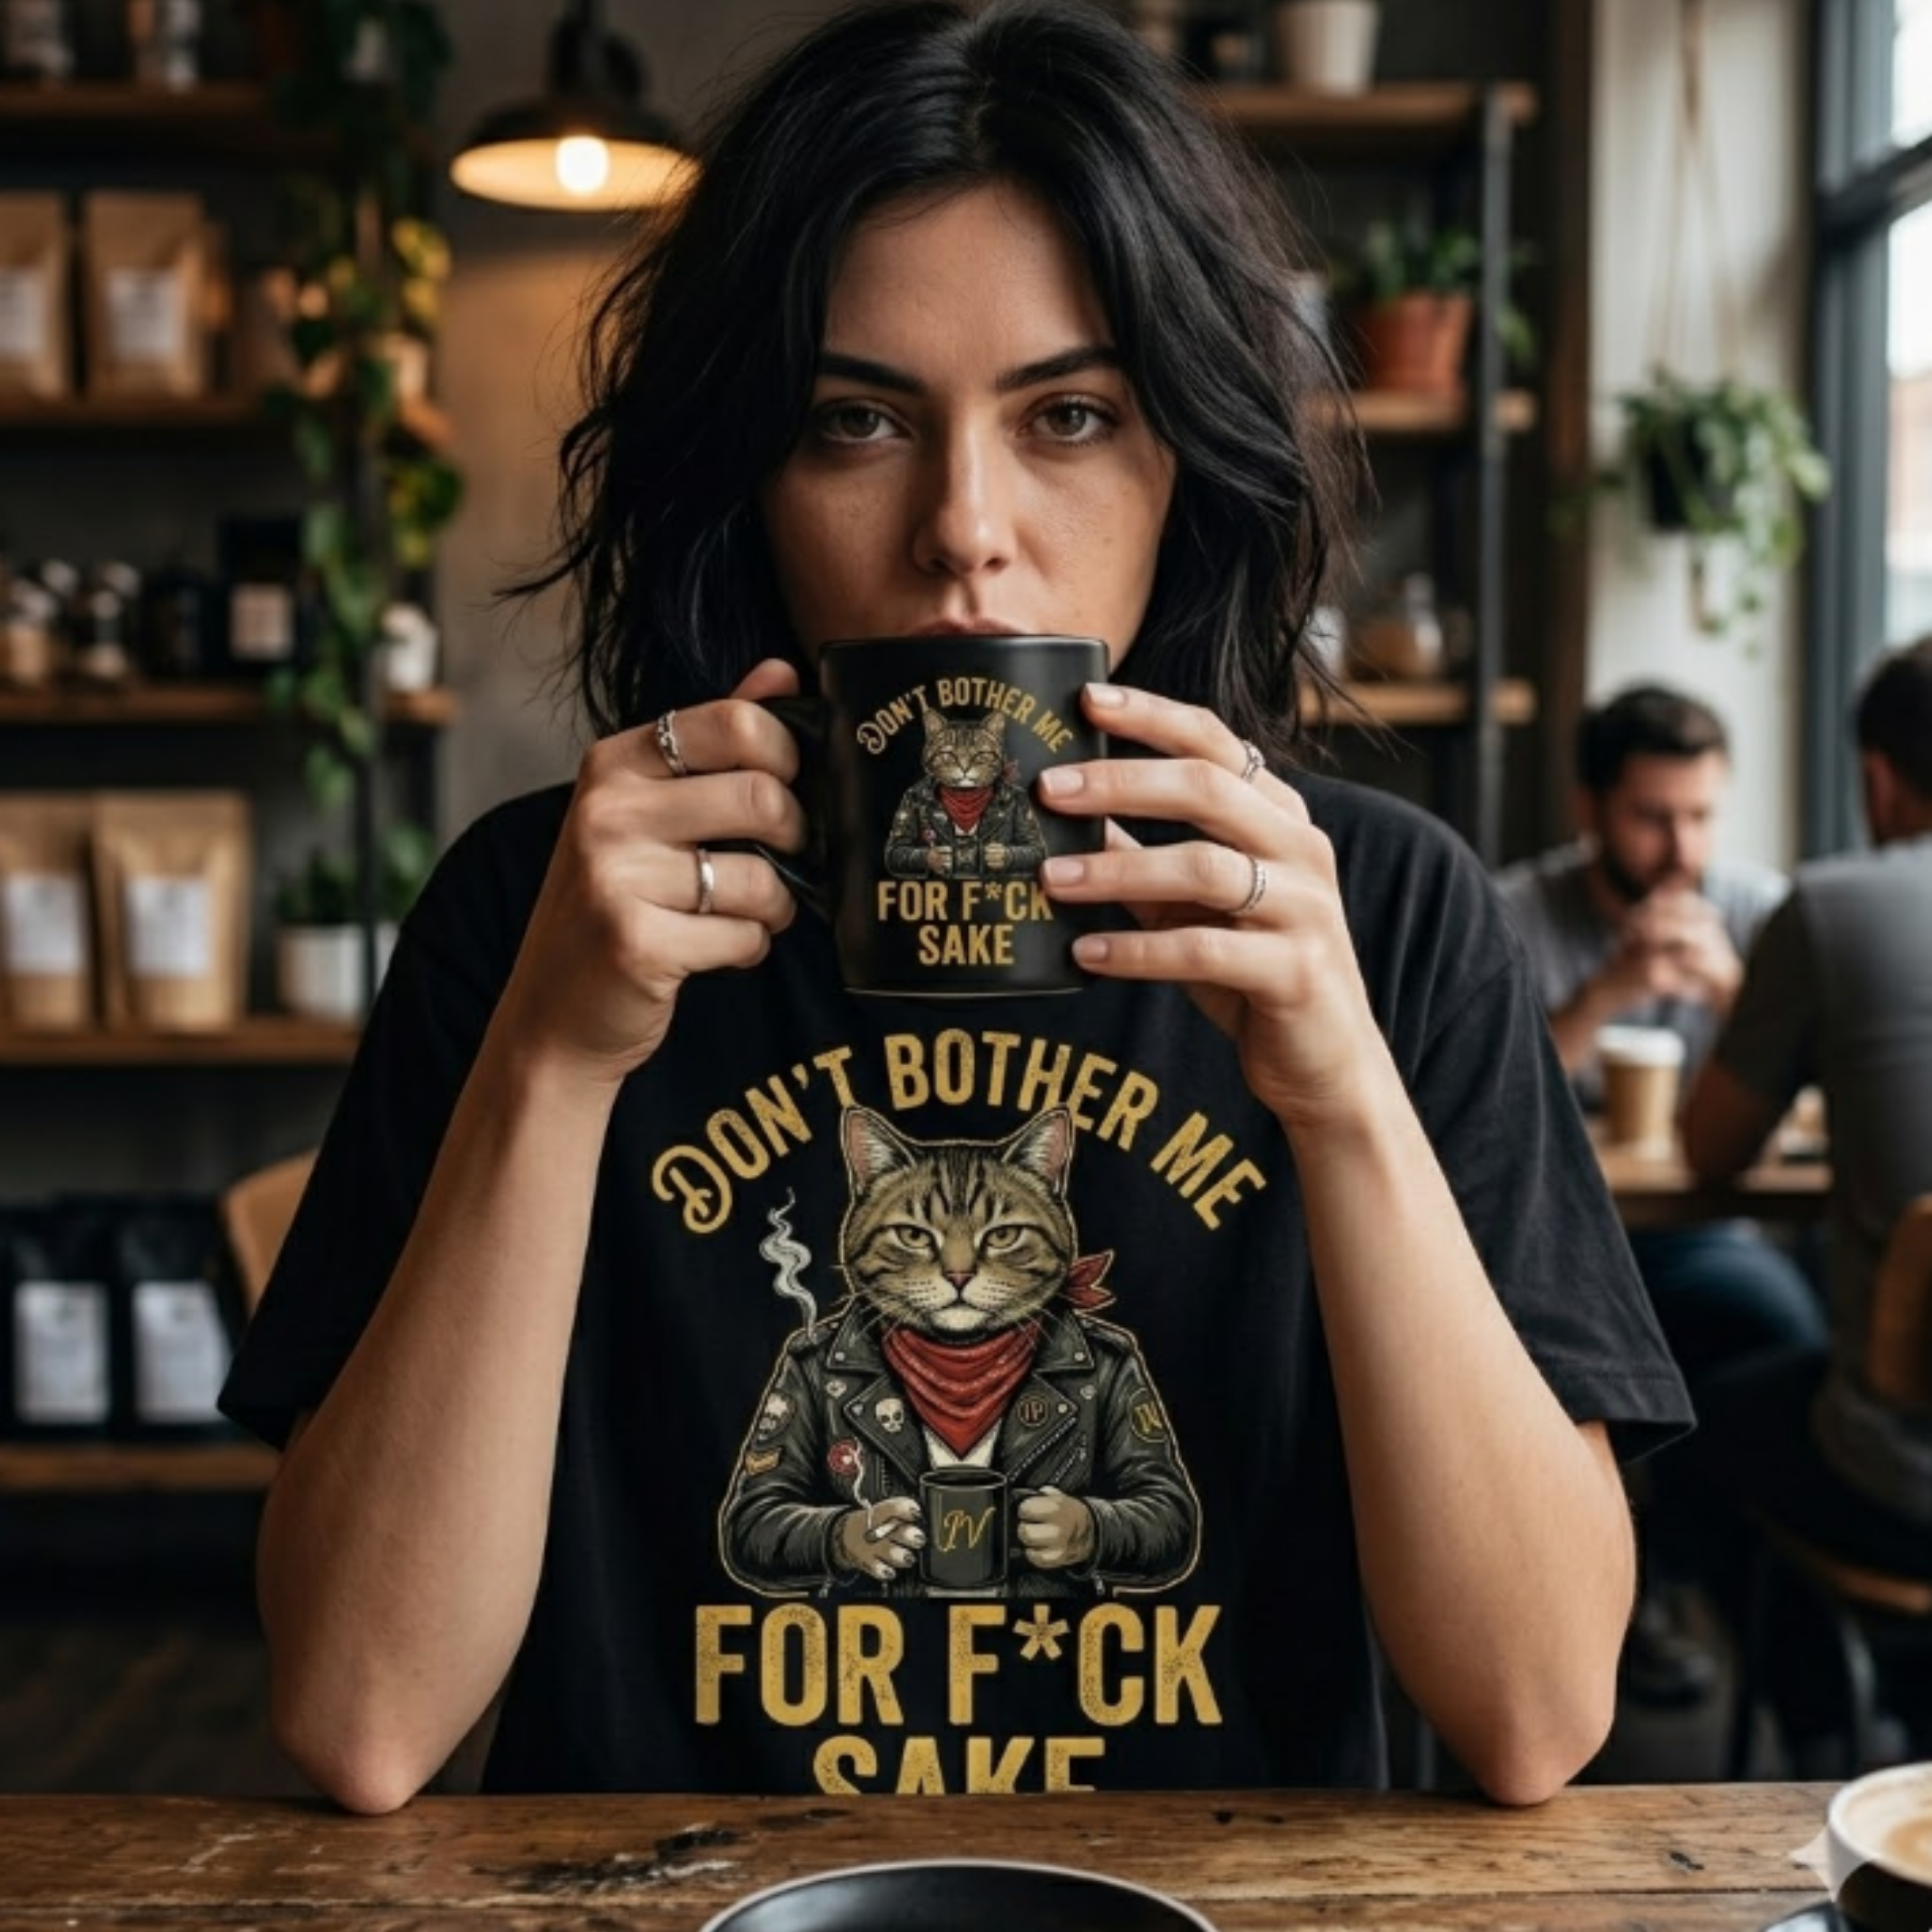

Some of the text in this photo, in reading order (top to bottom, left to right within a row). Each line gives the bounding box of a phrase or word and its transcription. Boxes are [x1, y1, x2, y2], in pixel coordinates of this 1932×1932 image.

[857, 676, 1074, 755] DON'T BOTHER ME
[878, 880, 948, 921] FOR
[919, 924, 1015, 966] SAKE
[651, 1028, 1267, 1234] DON'T BOTHER ME
[696, 1603, 904, 1726] FOR
